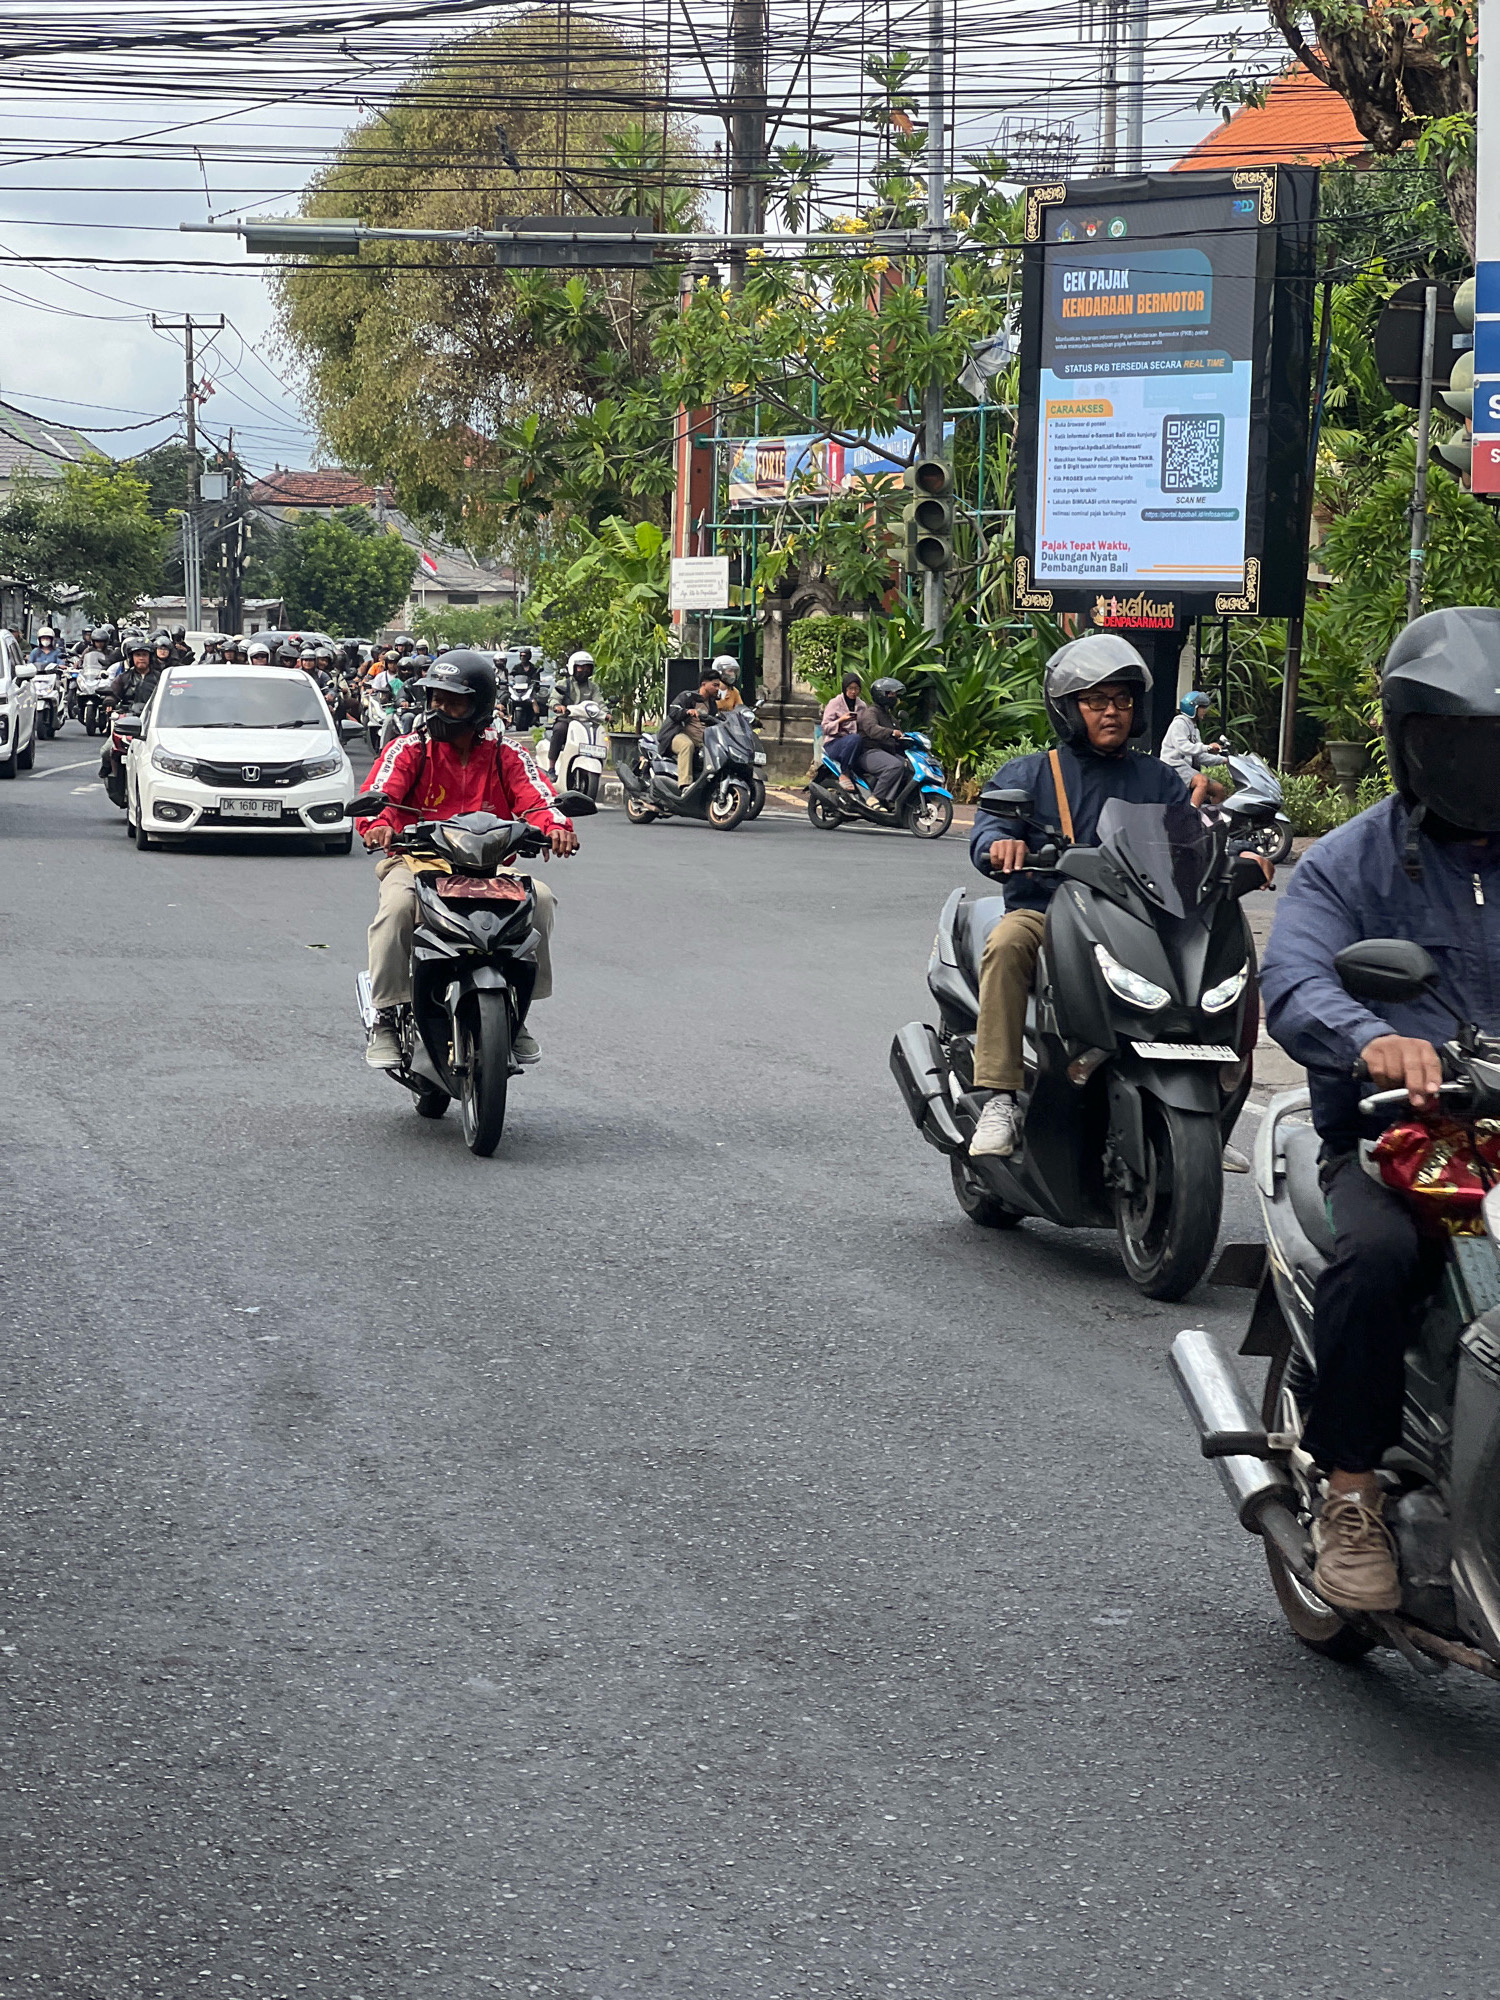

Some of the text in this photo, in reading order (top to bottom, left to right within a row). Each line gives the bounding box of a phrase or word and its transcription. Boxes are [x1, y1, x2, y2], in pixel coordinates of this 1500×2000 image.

[1063, 268, 1130, 292] CEK PAJAK
[1062, 290, 1204, 318] KENDARAAN BERMOTOR
[1064, 358, 1225, 374] STATUS PKB TERSEDIA SECARA REAL TIME
[1050, 404, 1104, 415] CARA AKSES
[756, 450, 786, 481] FORTE
[1041, 540, 1131, 552] Pajak Tepat Waktu,
[1041, 551, 1118, 564] Dukungan Nyata
[1041, 562, 1129, 574] Pembangunan Bali
[1143, 598, 1175, 618] Kuat
[1103, 616, 1175, 629] DENPASAR MAJU
[223, 801, 279, 812] DK 1610 FBT
